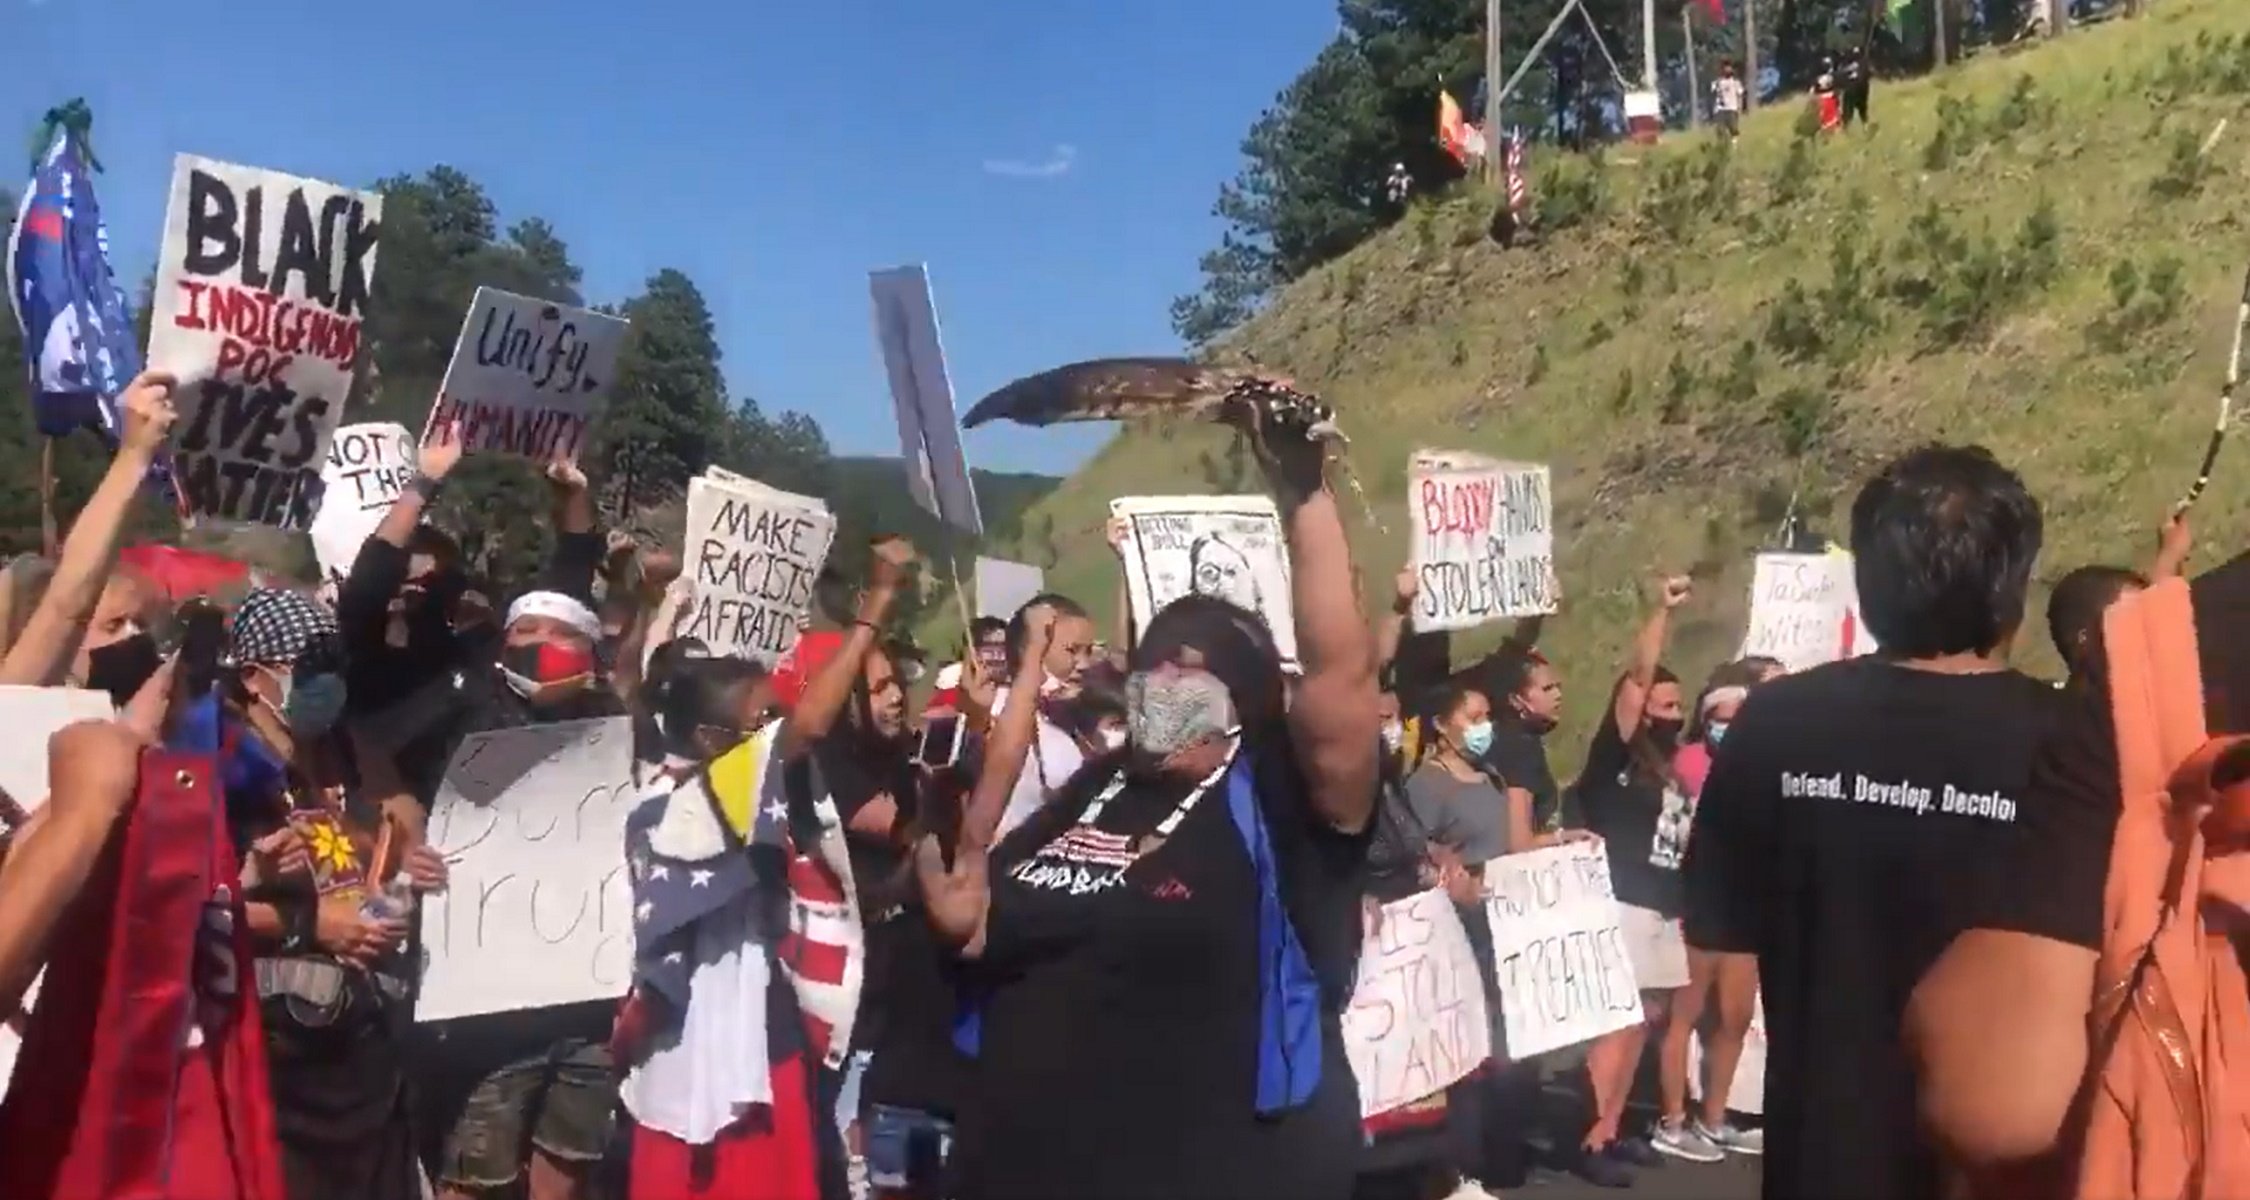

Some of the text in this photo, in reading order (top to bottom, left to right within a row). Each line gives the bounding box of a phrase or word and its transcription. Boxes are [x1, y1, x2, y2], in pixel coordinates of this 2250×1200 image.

[183, 169, 380, 317] BLACK
[477, 306, 588, 394] Unify
[181, 378, 330, 466] IVES
[711, 499, 815, 556] MAKE
[699, 538, 815, 608] RACISTS
[1421, 560, 1506, 617] STOLEN
[1781, 771, 1847, 801] Defend.
[1854, 774, 1936, 815] Develop.
